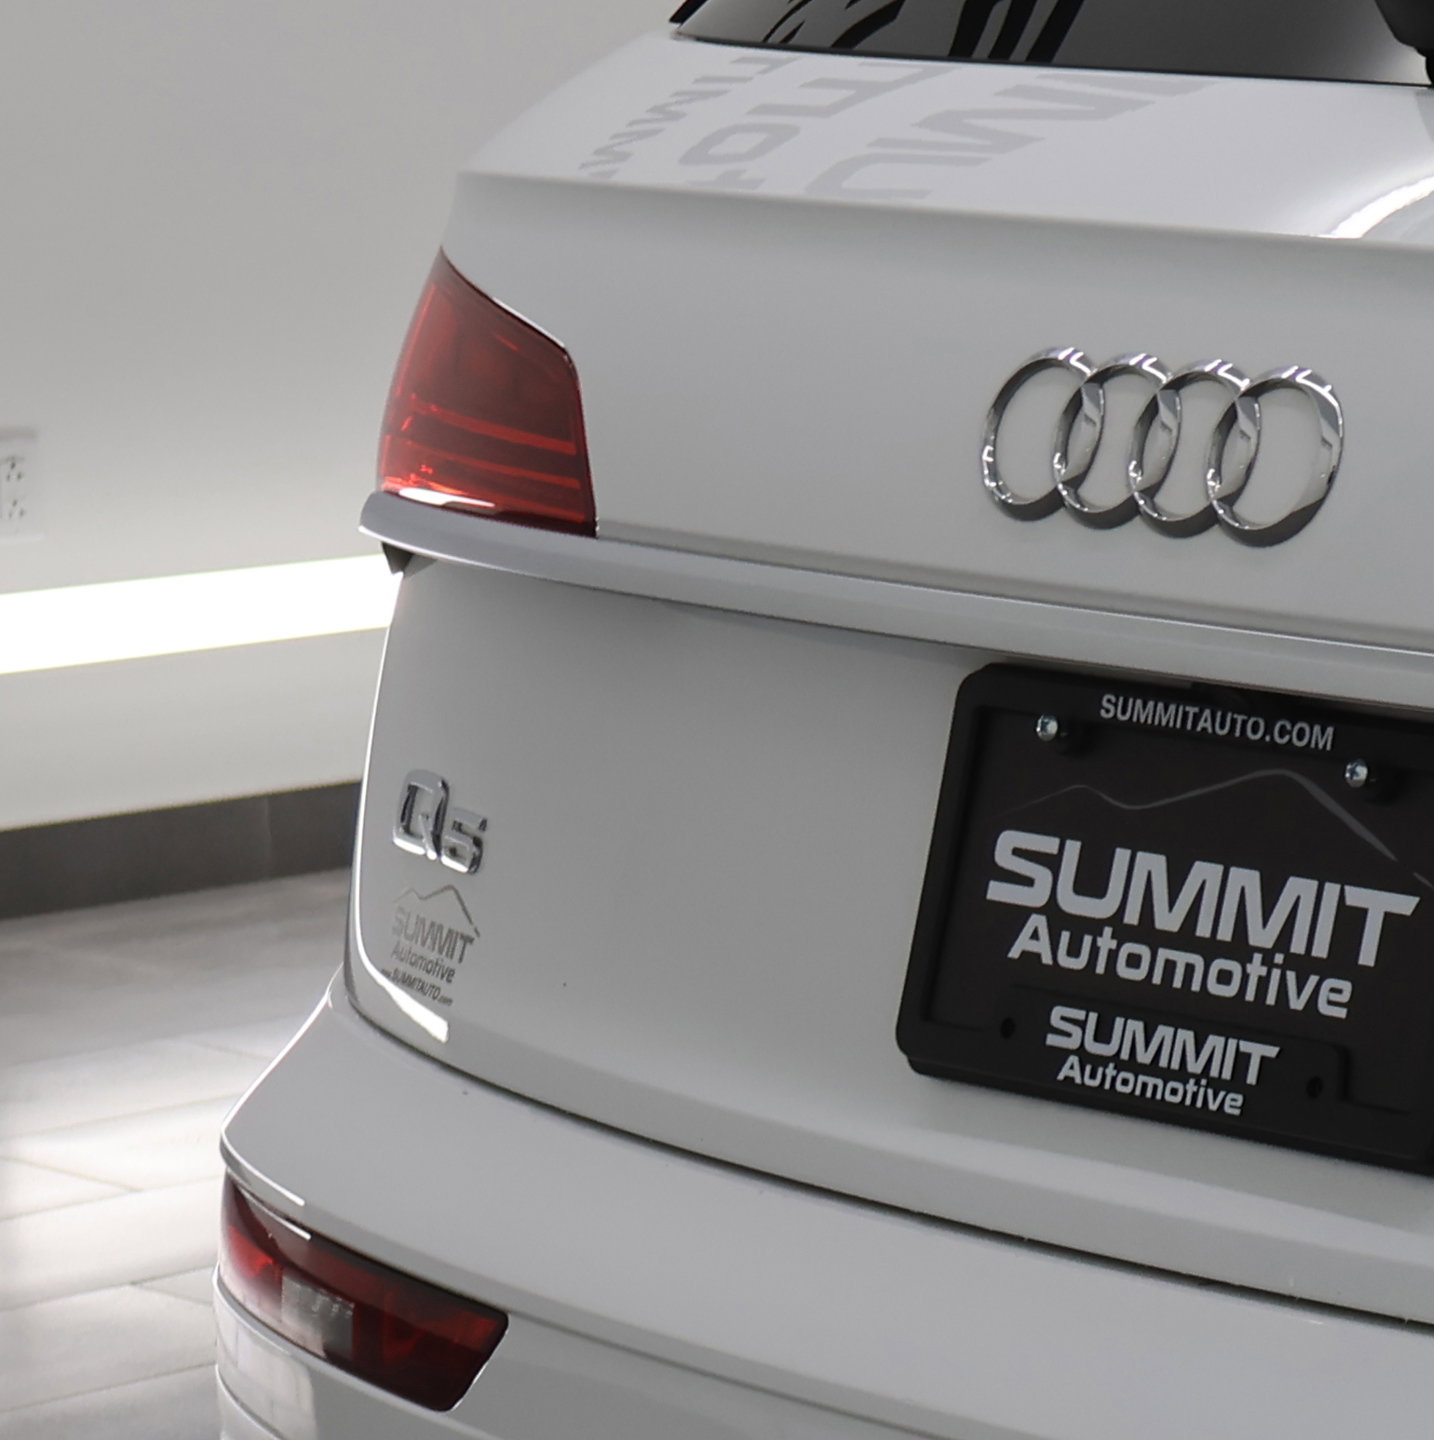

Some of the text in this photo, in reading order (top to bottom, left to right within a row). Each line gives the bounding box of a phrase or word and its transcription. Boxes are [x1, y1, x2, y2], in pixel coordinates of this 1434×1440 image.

[1100, 693, 1335, 751] SUMMITAUTO.COM
[392, 769, 488, 875] Q5
[986, 830, 1420, 967] SUMMIT
[391, 906, 476, 964] SUMMIT
[391, 944, 456, 984] Automotive
[1007, 913, 1354, 1019] Automotive
[1045, 1005, 1281, 1086] SUMMIT
[1056, 1054, 1244, 1116] Automotive
